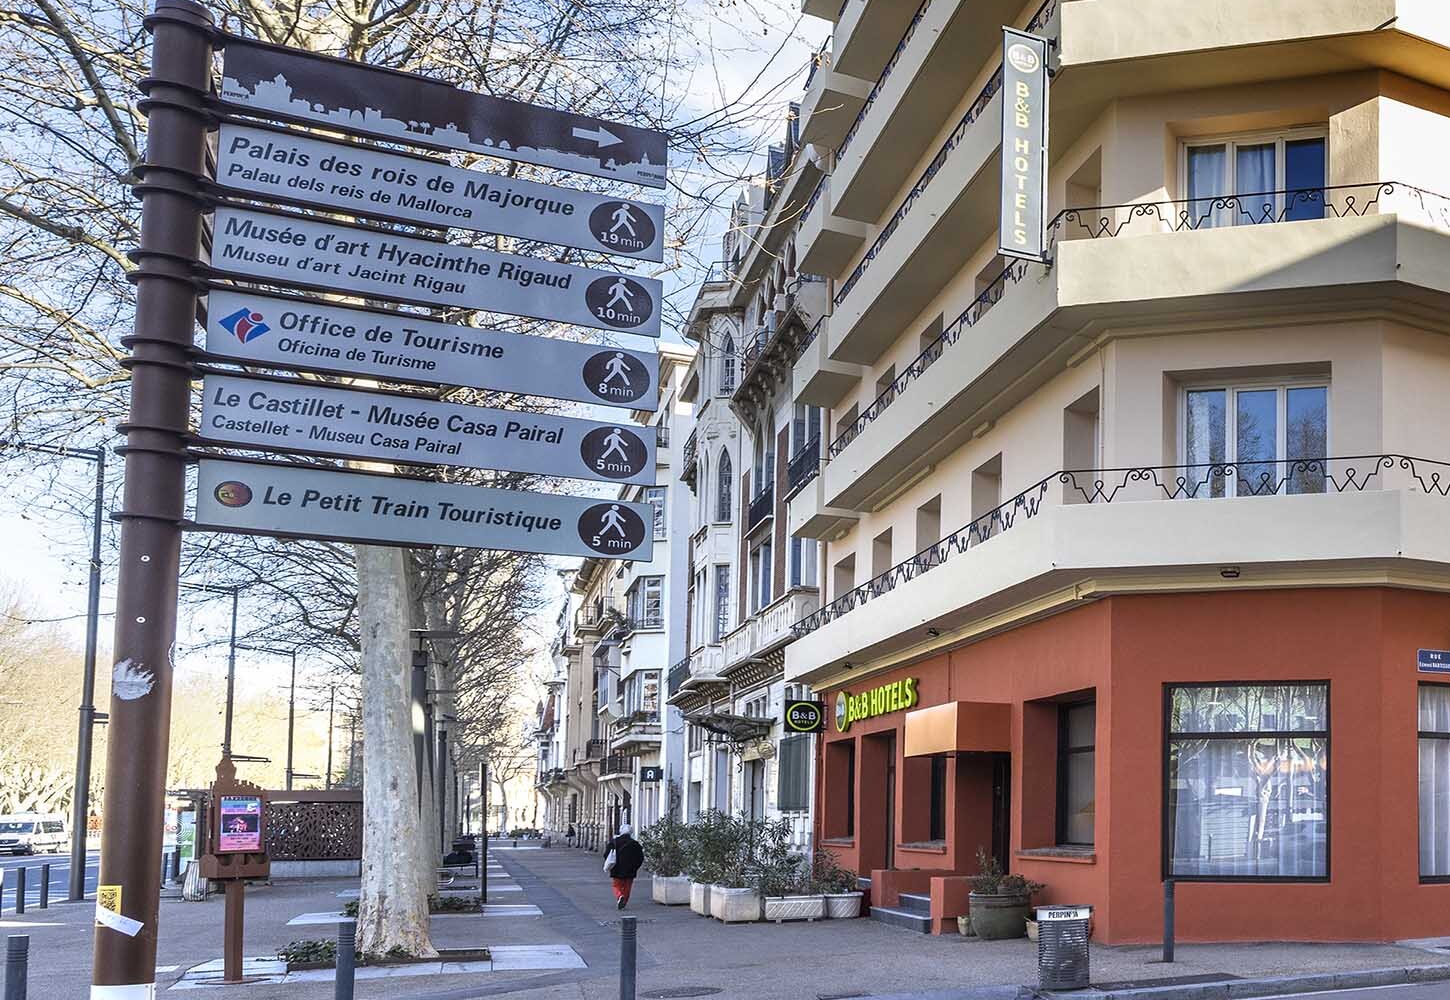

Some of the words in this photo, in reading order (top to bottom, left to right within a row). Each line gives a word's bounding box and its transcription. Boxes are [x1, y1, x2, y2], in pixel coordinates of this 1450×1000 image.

[1015, 80, 1030, 129] B&B
[228, 163, 282, 185] Palau
[287, 175, 325, 193] dels
[330, 184, 365, 199] reis
[369, 188, 391, 204] de
[397, 193, 472, 218] Mallorca
[229, 136, 310, 167] Palais
[319, 155, 363, 177] des
[371, 167, 418, 187] rois
[426, 176, 455, 194] de
[463, 180, 575, 216] Majorque
[1014, 137, 1030, 246] HOTELS
[222, 244, 289, 267] Museu
[296, 257, 341, 275] d'art
[348, 265, 407, 285] Jacint
[413, 274, 466, 294] Rigau
[224, 216, 307, 247] Musée
[314, 234, 370, 257] d'art
[377, 243, 491, 276] Hyacinthe
[497, 262, 572, 290] Rigaud
[278, 338, 340, 358] Oficina
[346, 348, 366, 362] de
[371, 350, 436, 371] Turisme
[279, 312, 355, 338] Office
[365, 326, 393, 343] de
[402, 328, 504, 358] Tourisme
[599, 383, 608, 394] 8
[610, 385, 634, 397] min
[212, 415, 290, 436] Castellet
[308, 425, 365, 444] Museu
[370, 432, 410, 449] Casa
[414, 437, 462, 455] Pairal
[214, 387, 240, 407] Le
[248, 391, 345, 419] Castillet
[367, 405, 440, 430] Musée
[447, 415, 498, 437] Casa
[504, 421, 564, 444] Pairal
[596, 459, 605, 470] 5
[607, 460, 631, 473] min
[263, 486, 292, 506] Le
[301, 489, 362, 513] Petit
[371, 495, 430, 519] Train
[438, 502, 562, 532] Touristique
[592, 535, 601, 547] 5
[608, 538, 632, 549] min
[792, 710, 817, 720] B&B
[848, 691, 869, 722] B&B
[870, 677, 914, 716] HOTELS
